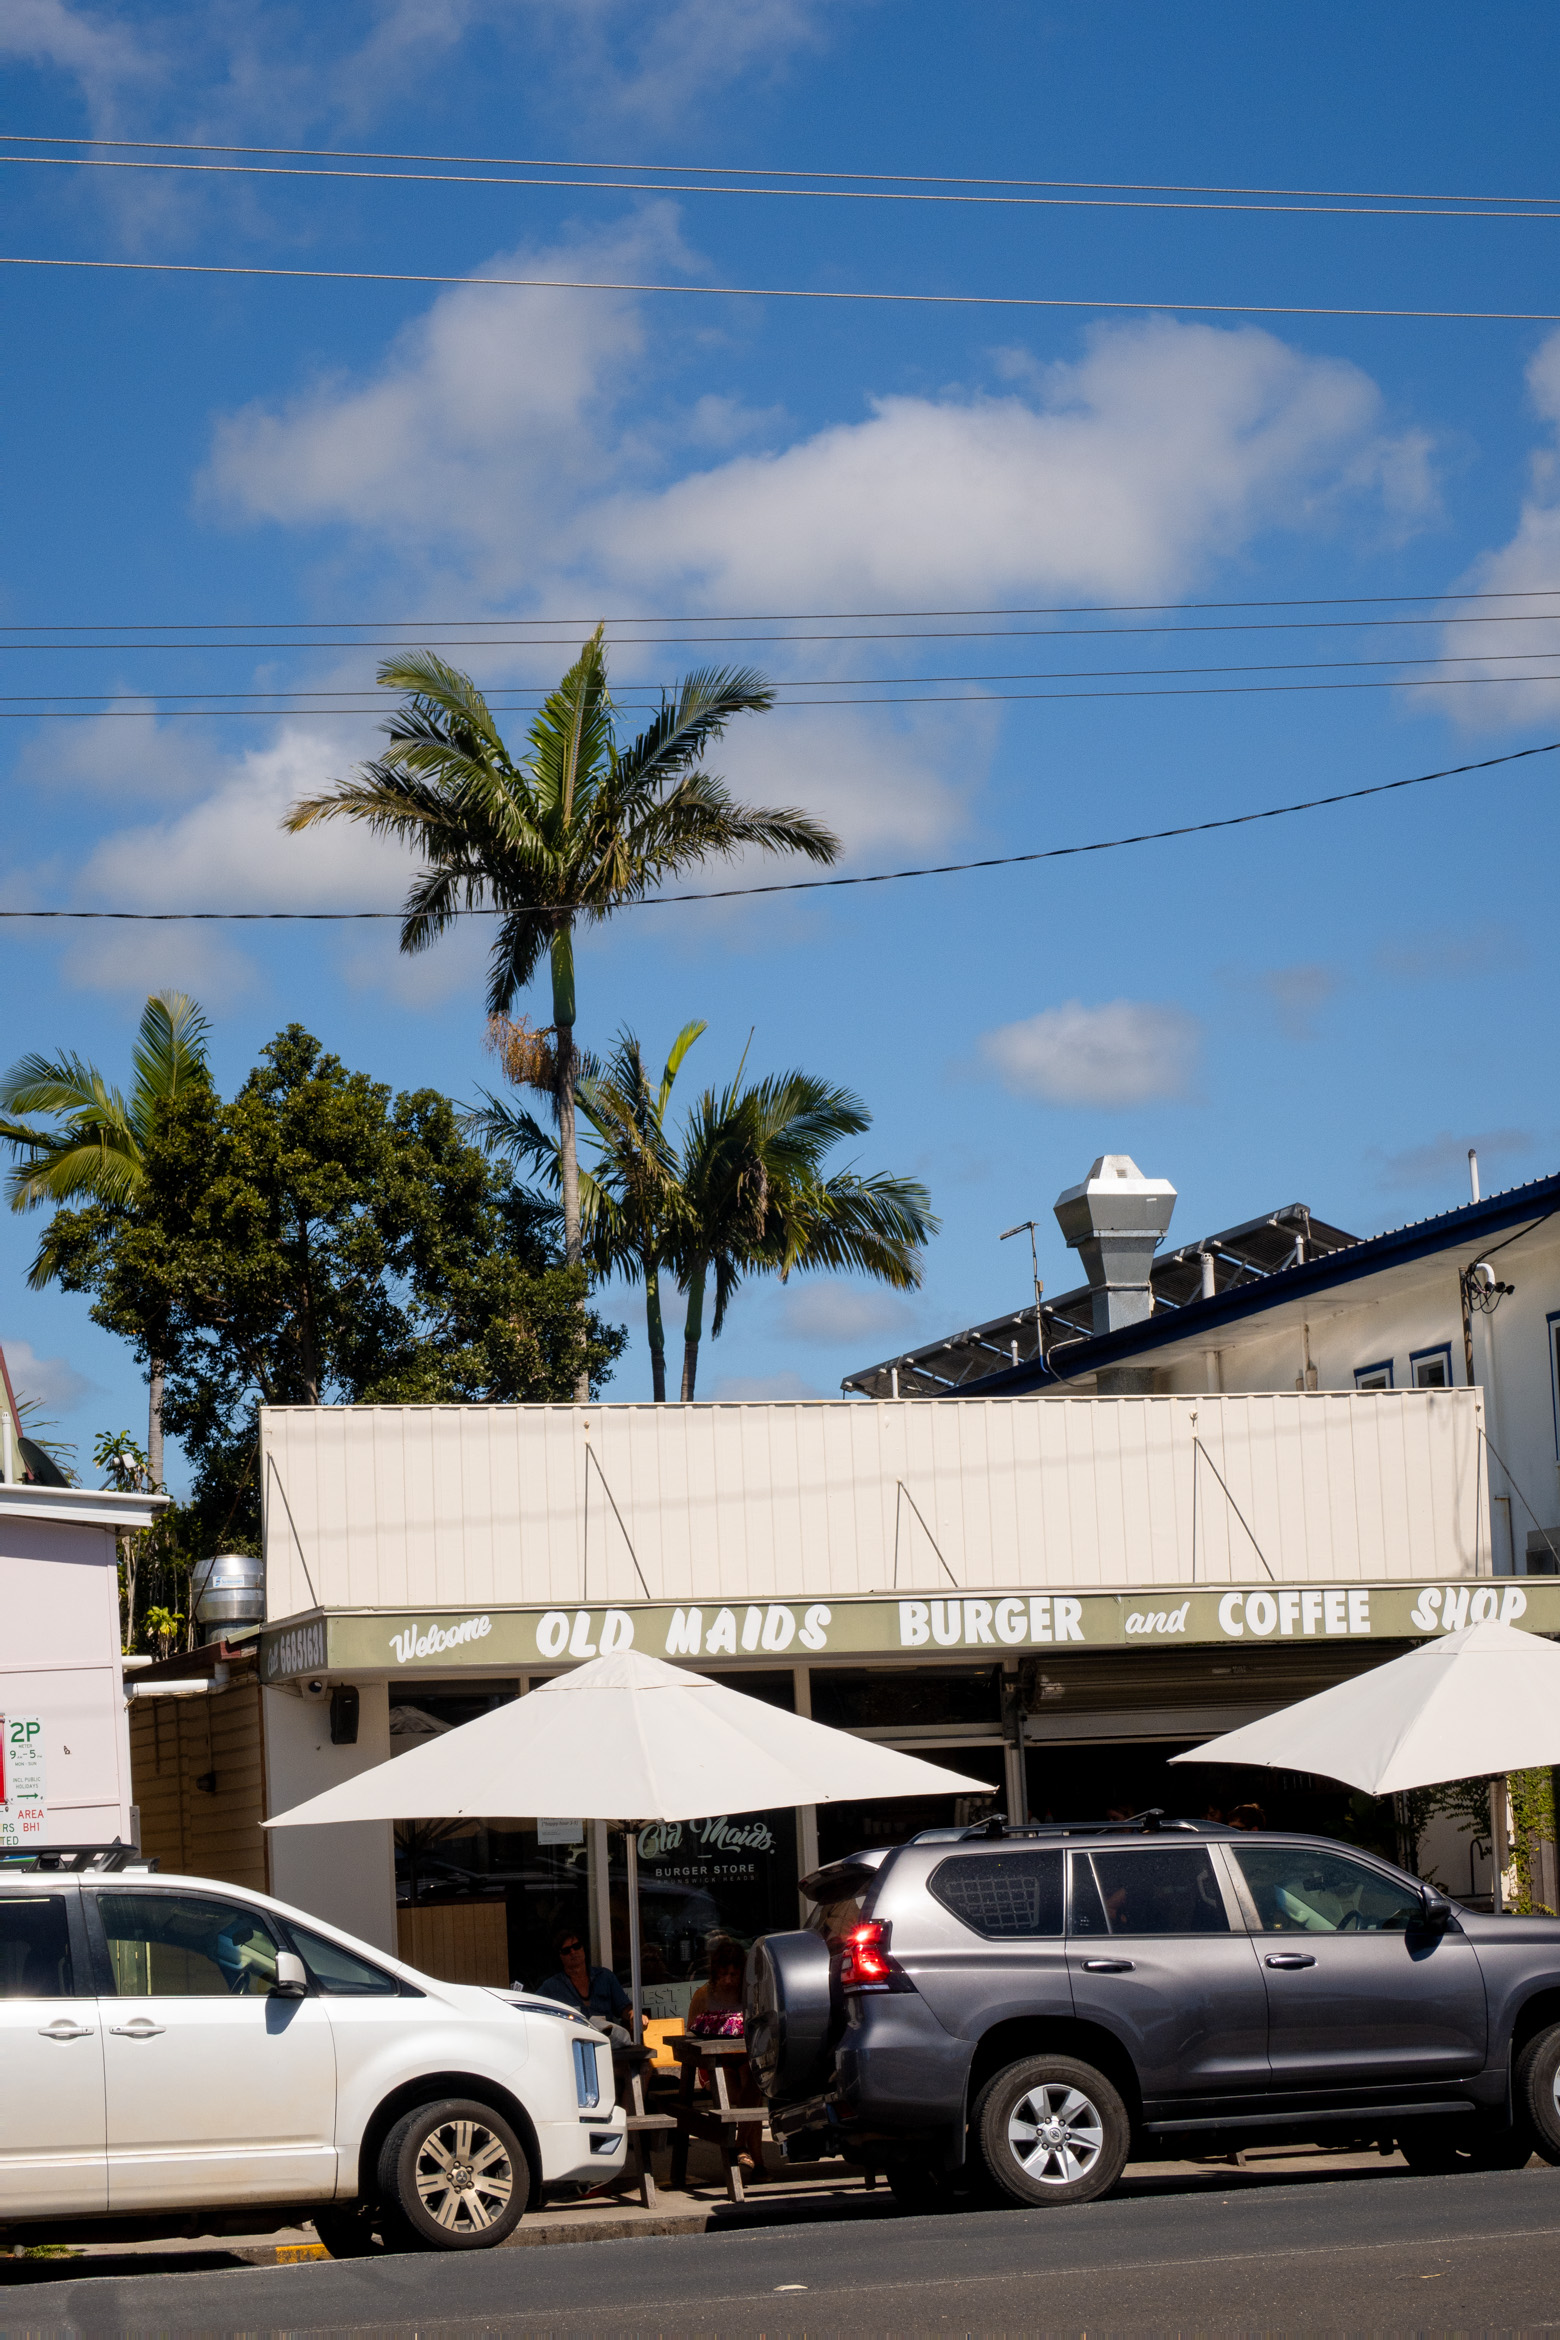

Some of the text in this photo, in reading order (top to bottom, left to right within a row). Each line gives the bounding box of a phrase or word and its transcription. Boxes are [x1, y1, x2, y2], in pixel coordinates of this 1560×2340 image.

[389, 1586, 1527, 1663] Welcome OLD MAIDS BURGER and COFFEE SHOP
[10, 1722, 40, 1742] 2P
[18, 1809, 45, 1819] AREA
[23, 1822, 40, 1832] BH1
[637, 1822, 684, 1860] Old
[655, 1864, 755, 1877] BURGER STORE
[656, 1877, 717, 1885] BRUNSWICK
